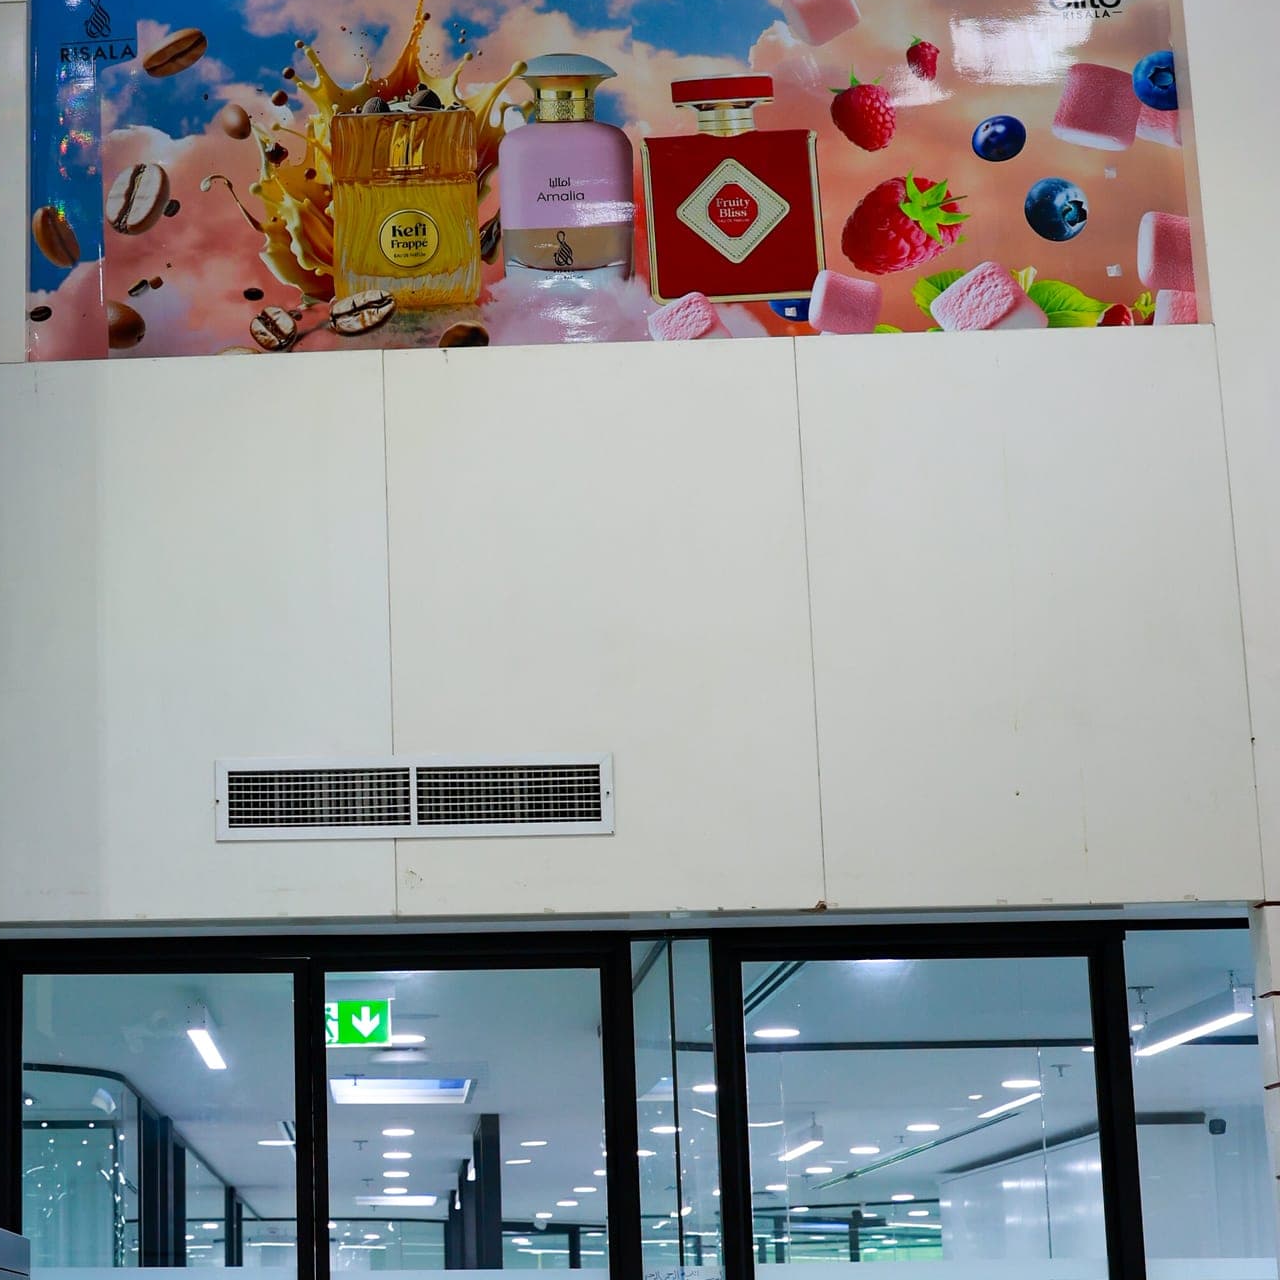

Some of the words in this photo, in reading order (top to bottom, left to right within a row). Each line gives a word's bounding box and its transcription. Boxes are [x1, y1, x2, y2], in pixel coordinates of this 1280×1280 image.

[536, 190, 584, 201] Amalia
[715, 197, 750, 209] Fruity
[720, 208, 747, 218] Bliss
[391, 223, 426, 237] Kefi
